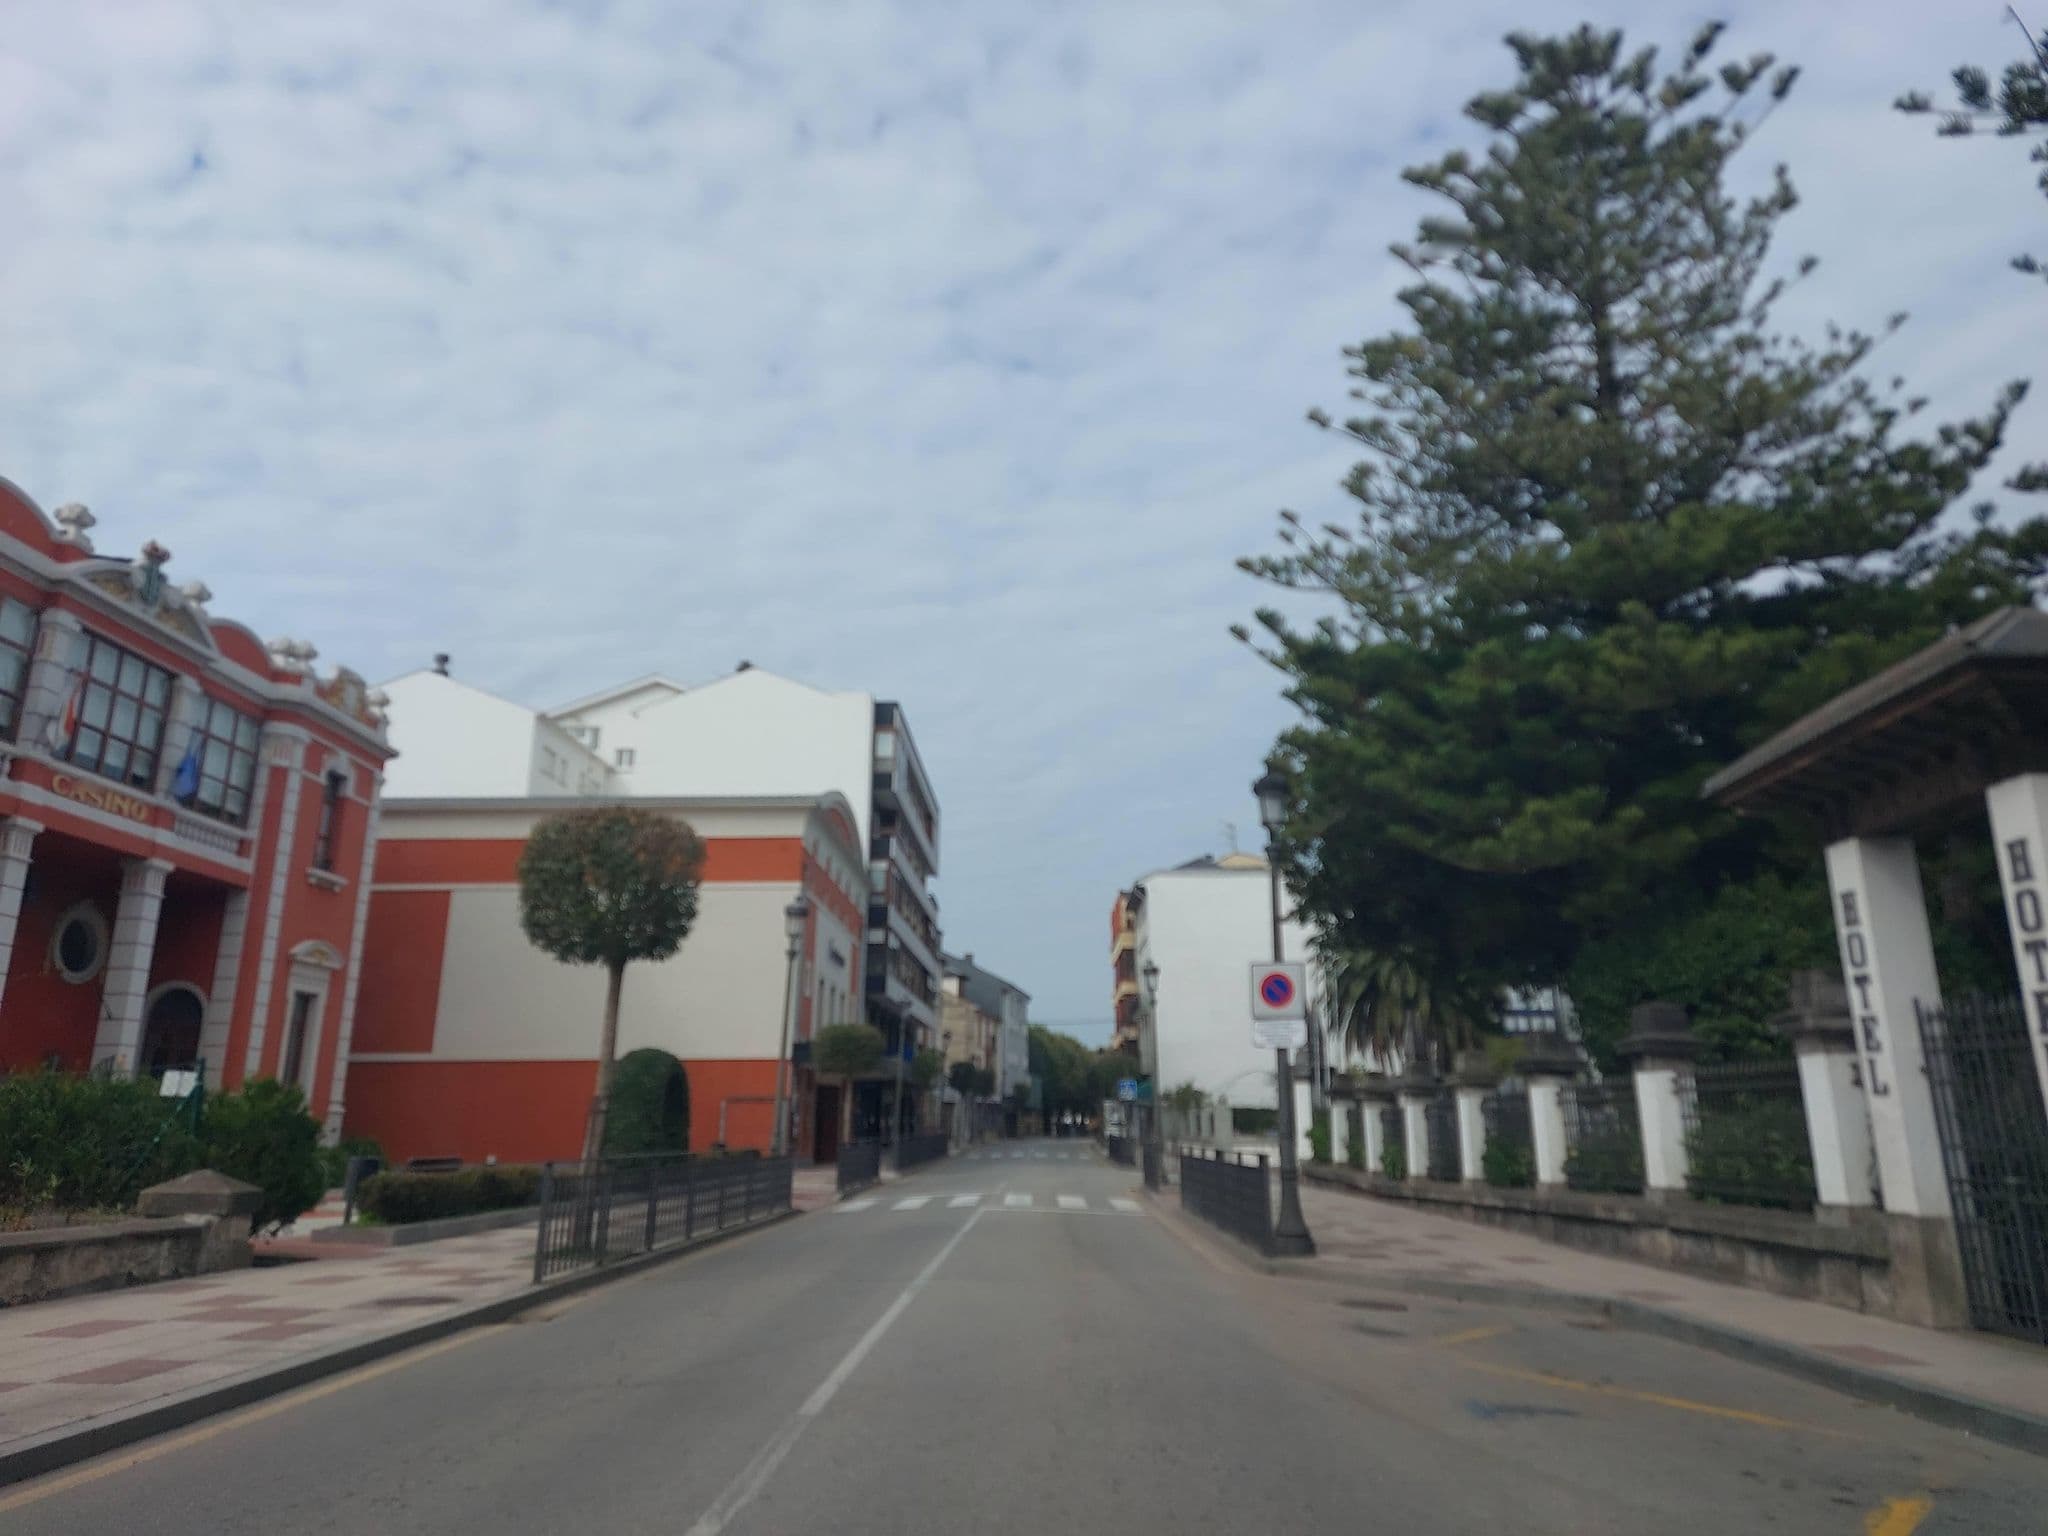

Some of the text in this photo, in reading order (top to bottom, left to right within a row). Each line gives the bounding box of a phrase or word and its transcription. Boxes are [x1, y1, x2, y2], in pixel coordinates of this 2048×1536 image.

[52, 774, 149, 821] CASINO
[1841, 891, 1889, 1096] HOTEL
[2006, 837, 2048, 1056] HOT
